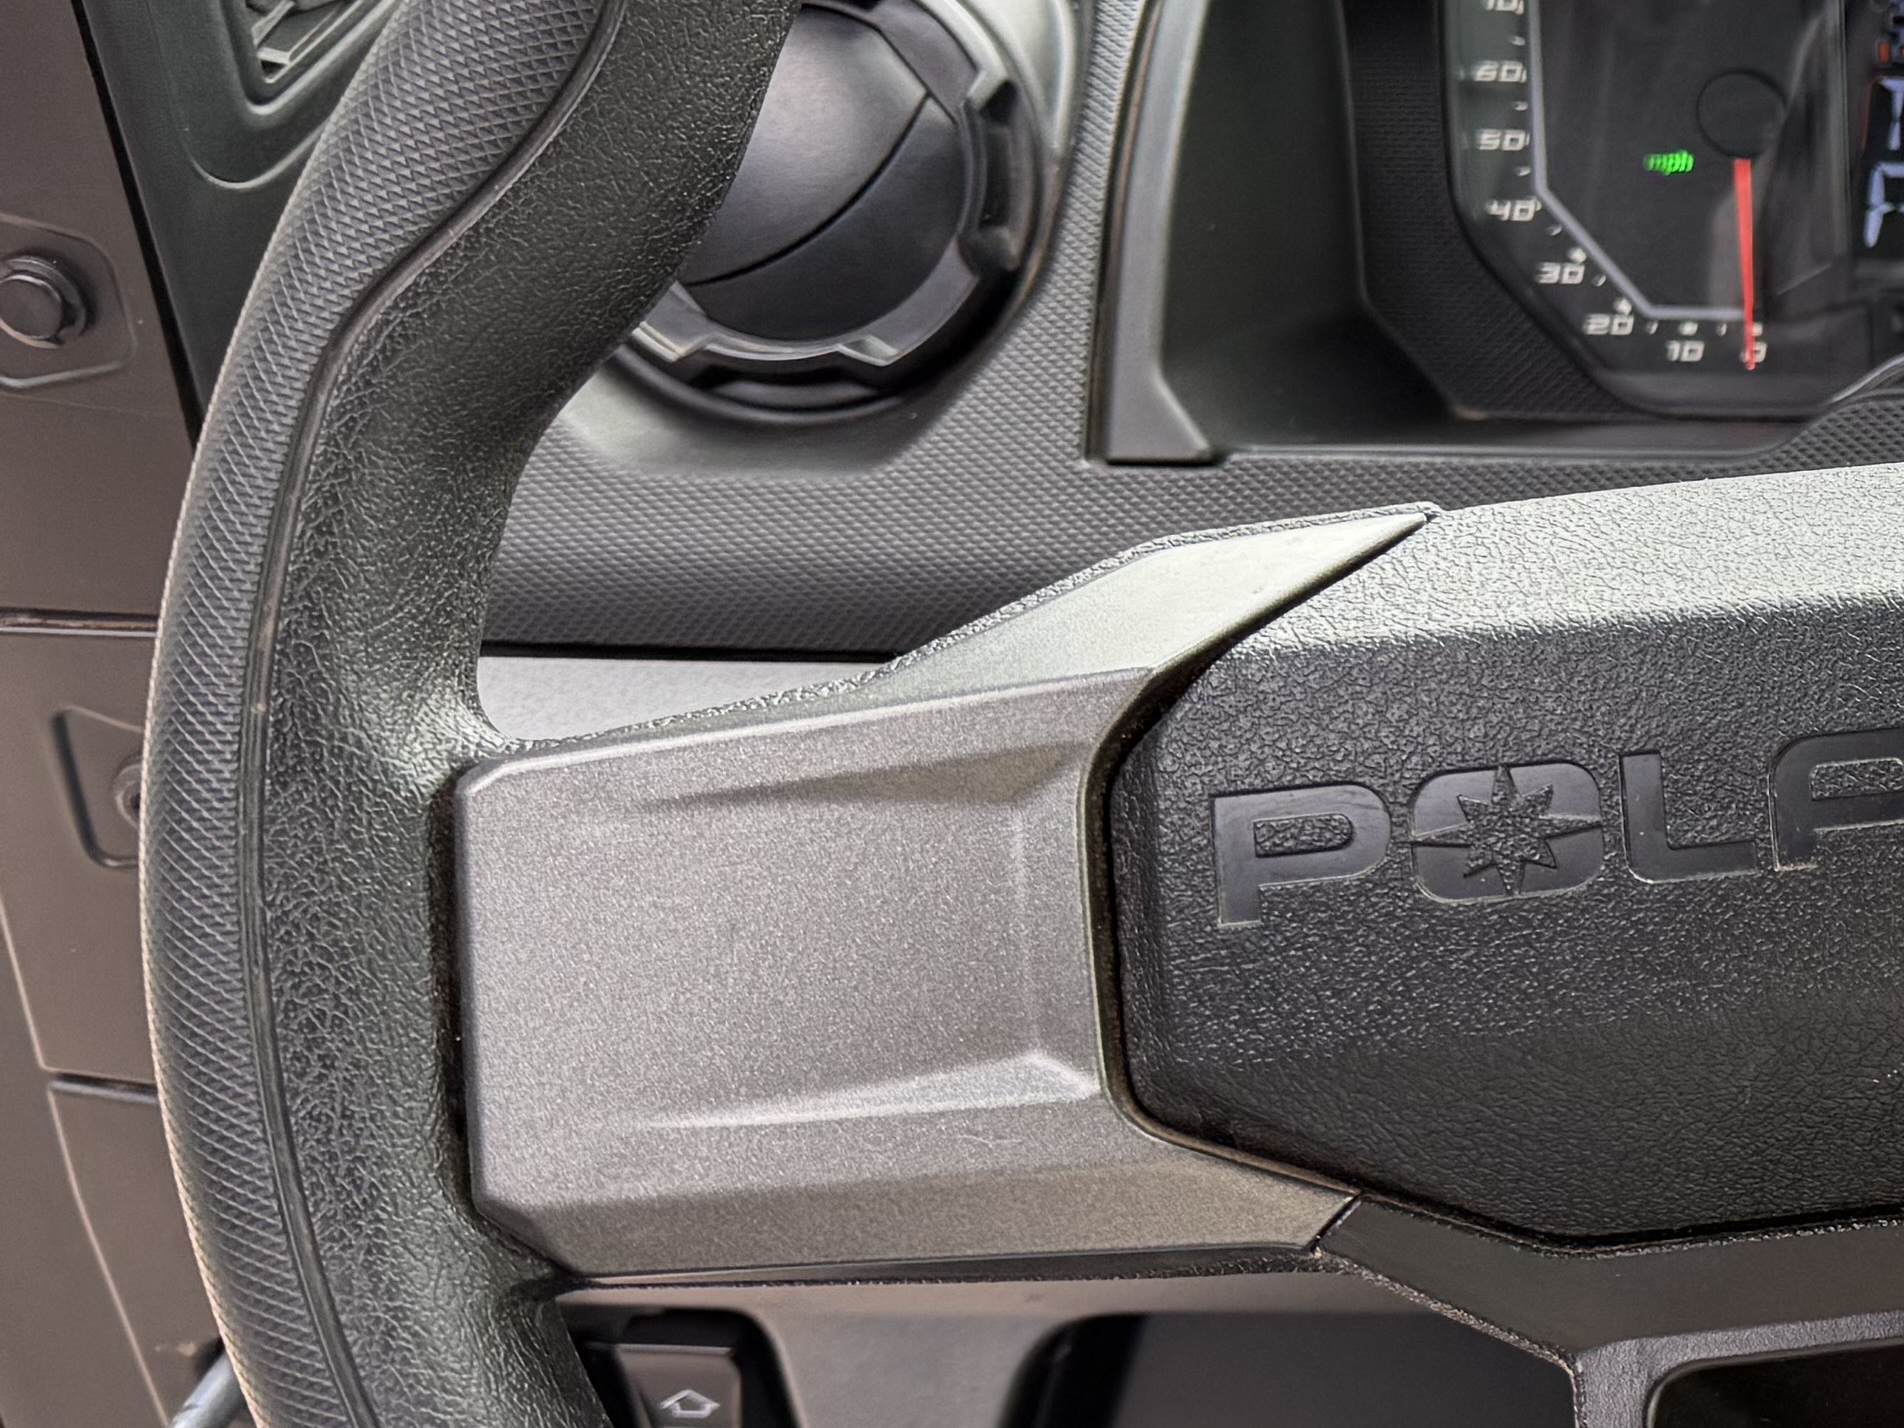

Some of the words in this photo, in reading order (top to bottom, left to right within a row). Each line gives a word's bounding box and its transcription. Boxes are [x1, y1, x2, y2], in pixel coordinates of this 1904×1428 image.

[1472, 60, 1522, 83] 60
[1477, 129, 1527, 151] 50
[1487, 200, 1536, 222] 40
[1537, 263, 1585, 284] 30
[1583, 314, 1634, 335] 20
[1666, 341, 1704, 362] 10
